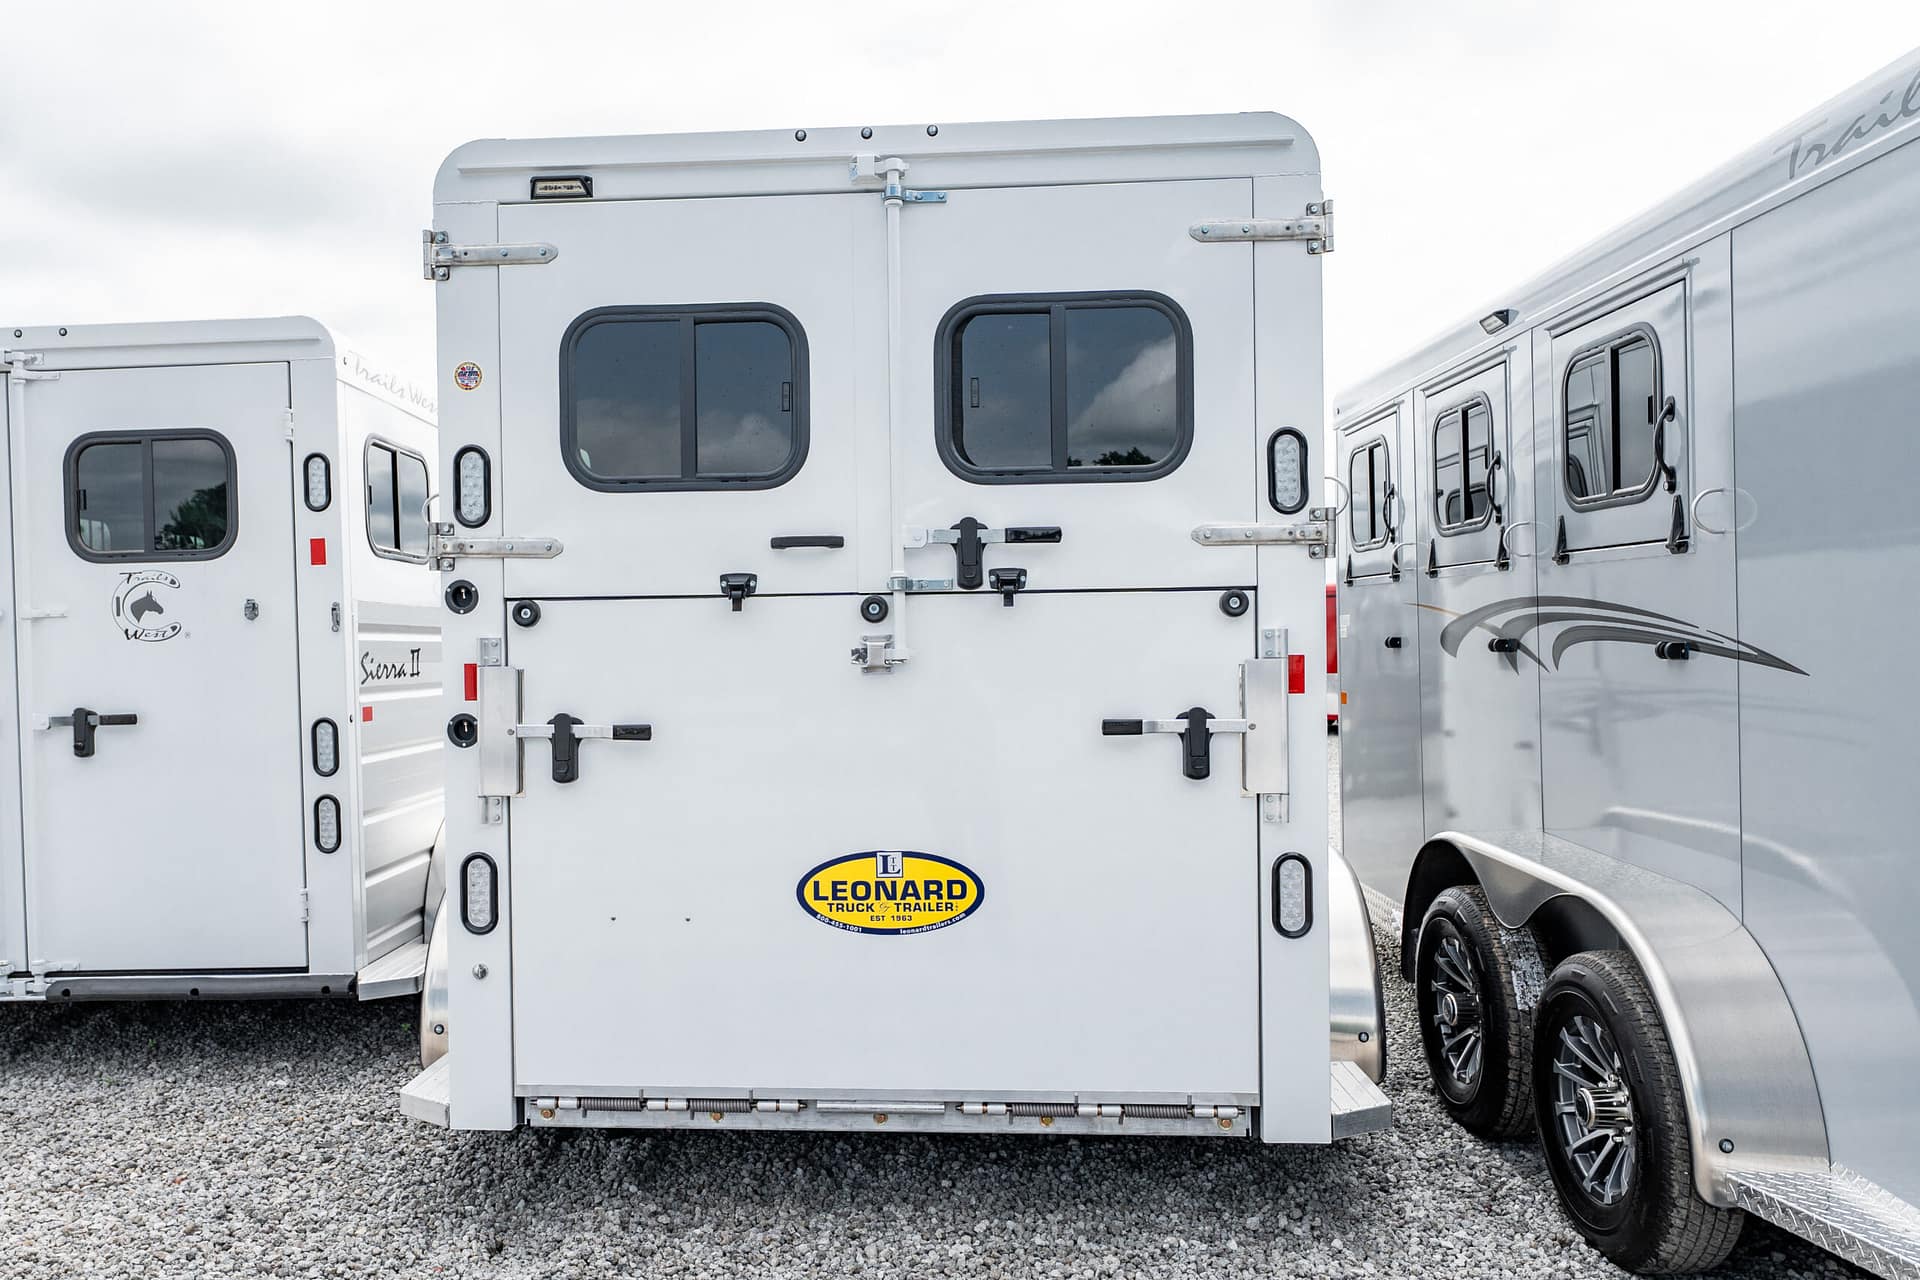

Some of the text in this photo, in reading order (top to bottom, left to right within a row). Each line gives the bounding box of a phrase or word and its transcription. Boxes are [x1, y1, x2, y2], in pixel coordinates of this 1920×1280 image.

[347, 350, 438, 413] Trails Wes
[120, 571, 168, 584] Trails
[124, 628, 168, 641] West
[360, 648, 421, 685] Sierra II
[812, 879, 968, 902] LEONARD
[827, 902, 875, 913] TRUCK
[894, 902, 954, 912] TRAILER
[815, 913, 863, 933] 800-455-1001
[900, 912, 967, 935] leonardtrailers.com
